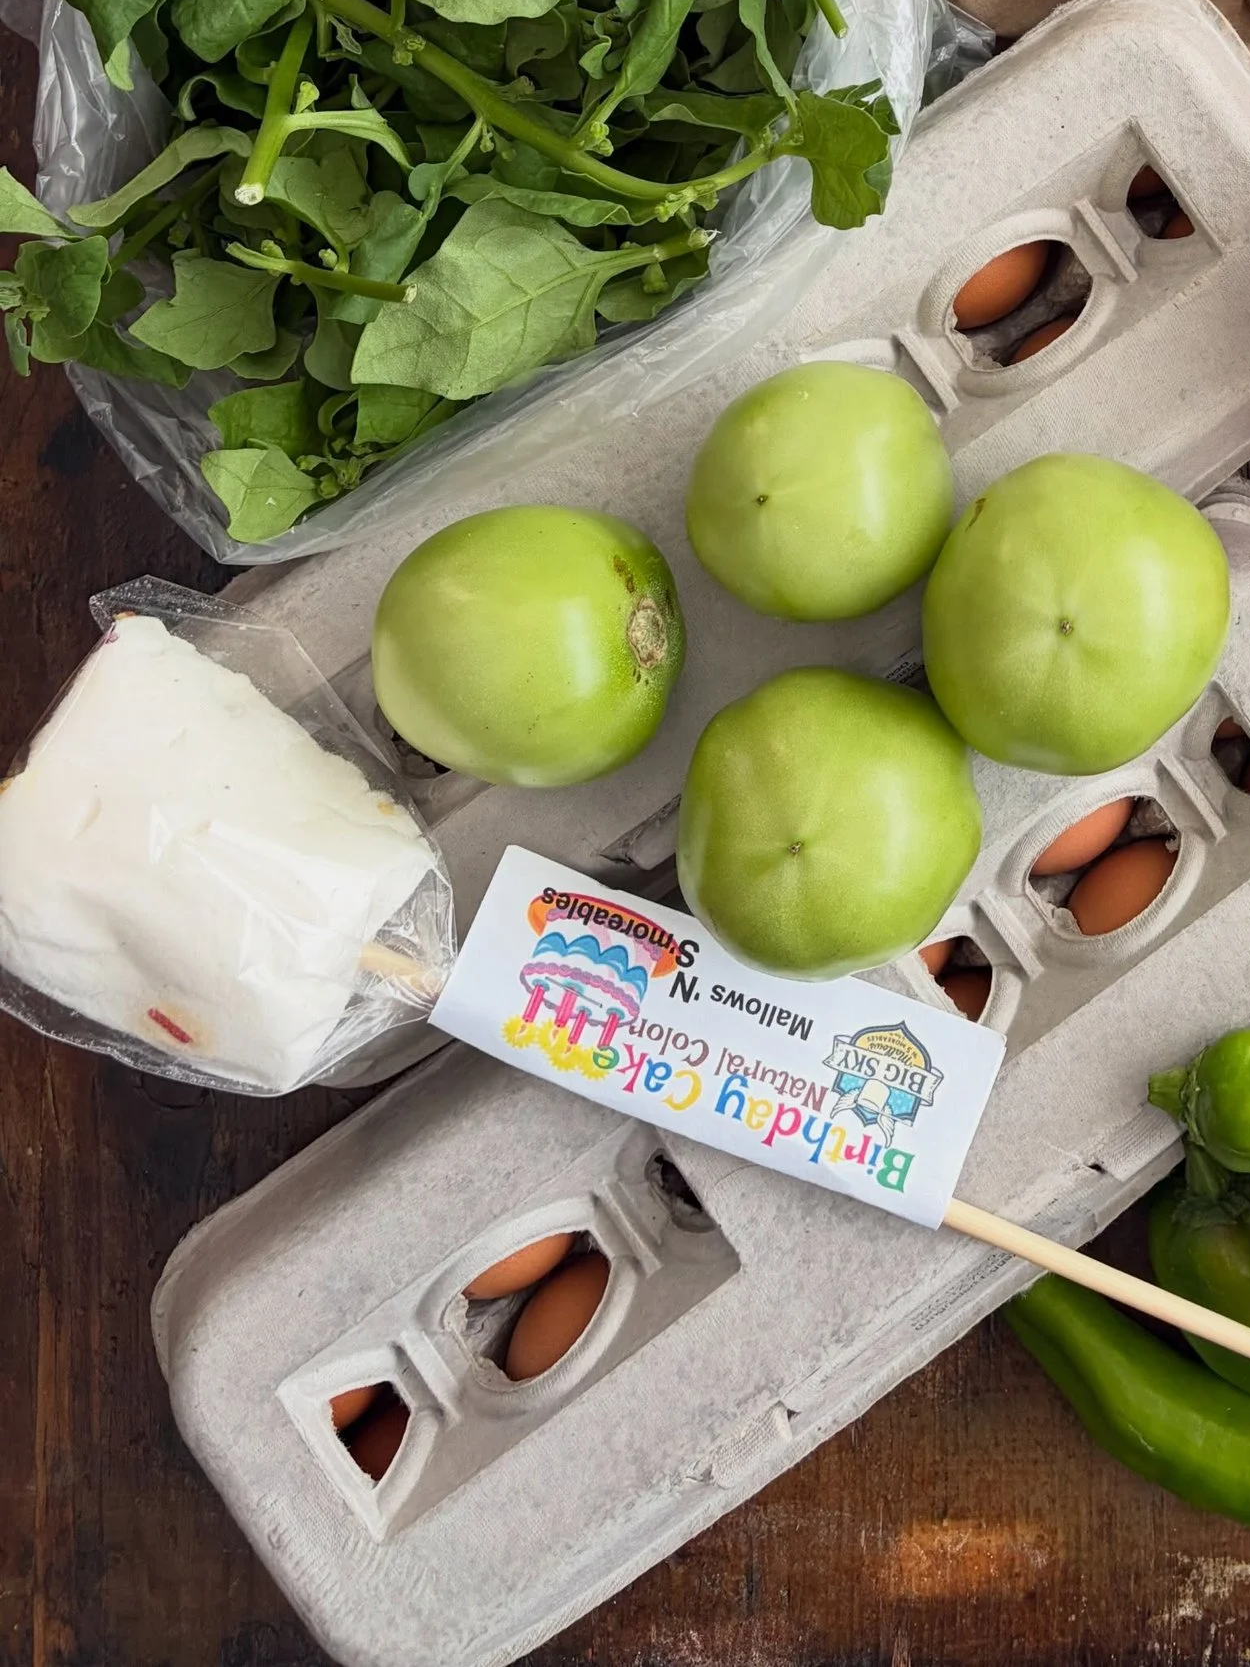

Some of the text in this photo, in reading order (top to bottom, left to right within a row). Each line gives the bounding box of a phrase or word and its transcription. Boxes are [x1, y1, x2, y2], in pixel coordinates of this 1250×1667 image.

[541, 887, 699, 968] S'moreables
[669, 971, 814, 1041] Mallows 'N
[629, 1018, 829, 1113] Natural Color
[837, 1049, 927, 1094] BIG SKY
[593, 1042, 914, 1193] Birthday Cake
